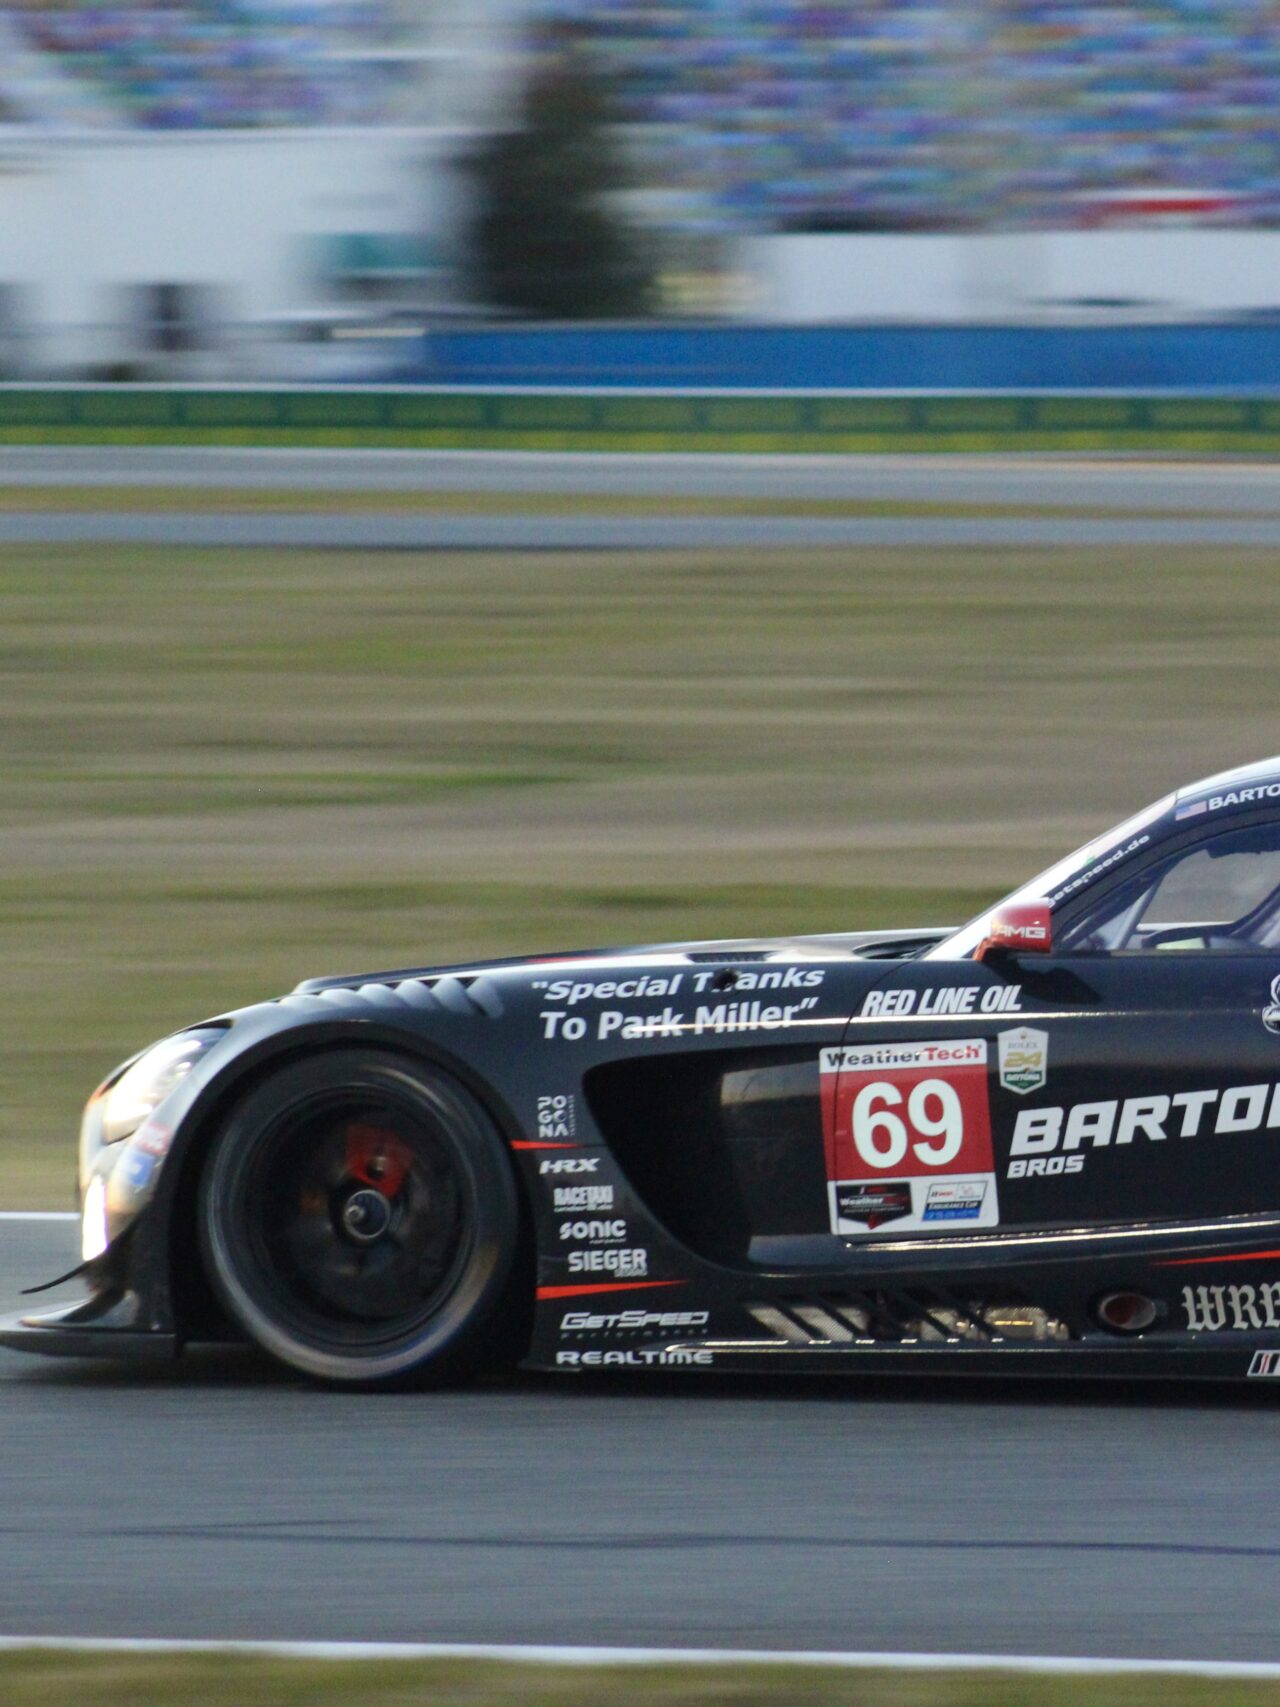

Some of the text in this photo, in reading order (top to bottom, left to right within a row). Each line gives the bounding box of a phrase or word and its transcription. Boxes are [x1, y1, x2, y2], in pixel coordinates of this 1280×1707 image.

[995, 925, 1046, 939] AMG
[693, 967, 825, 993] Tanks
[861, 985, 1022, 1017] RED LINE OIL
[540, 1011, 587, 1041] To
[597, 1007, 685, 1040] Park
[1004, 1051, 1042, 1068] 24
[852, 1078, 964, 1168] 69
[539, 1158, 600, 1174] HRX
[1006, 1154, 1085, 1179] BROS
[567, 1248, 646, 1272] SIEGER
[556, 1350, 713, 1365] REALTIME
